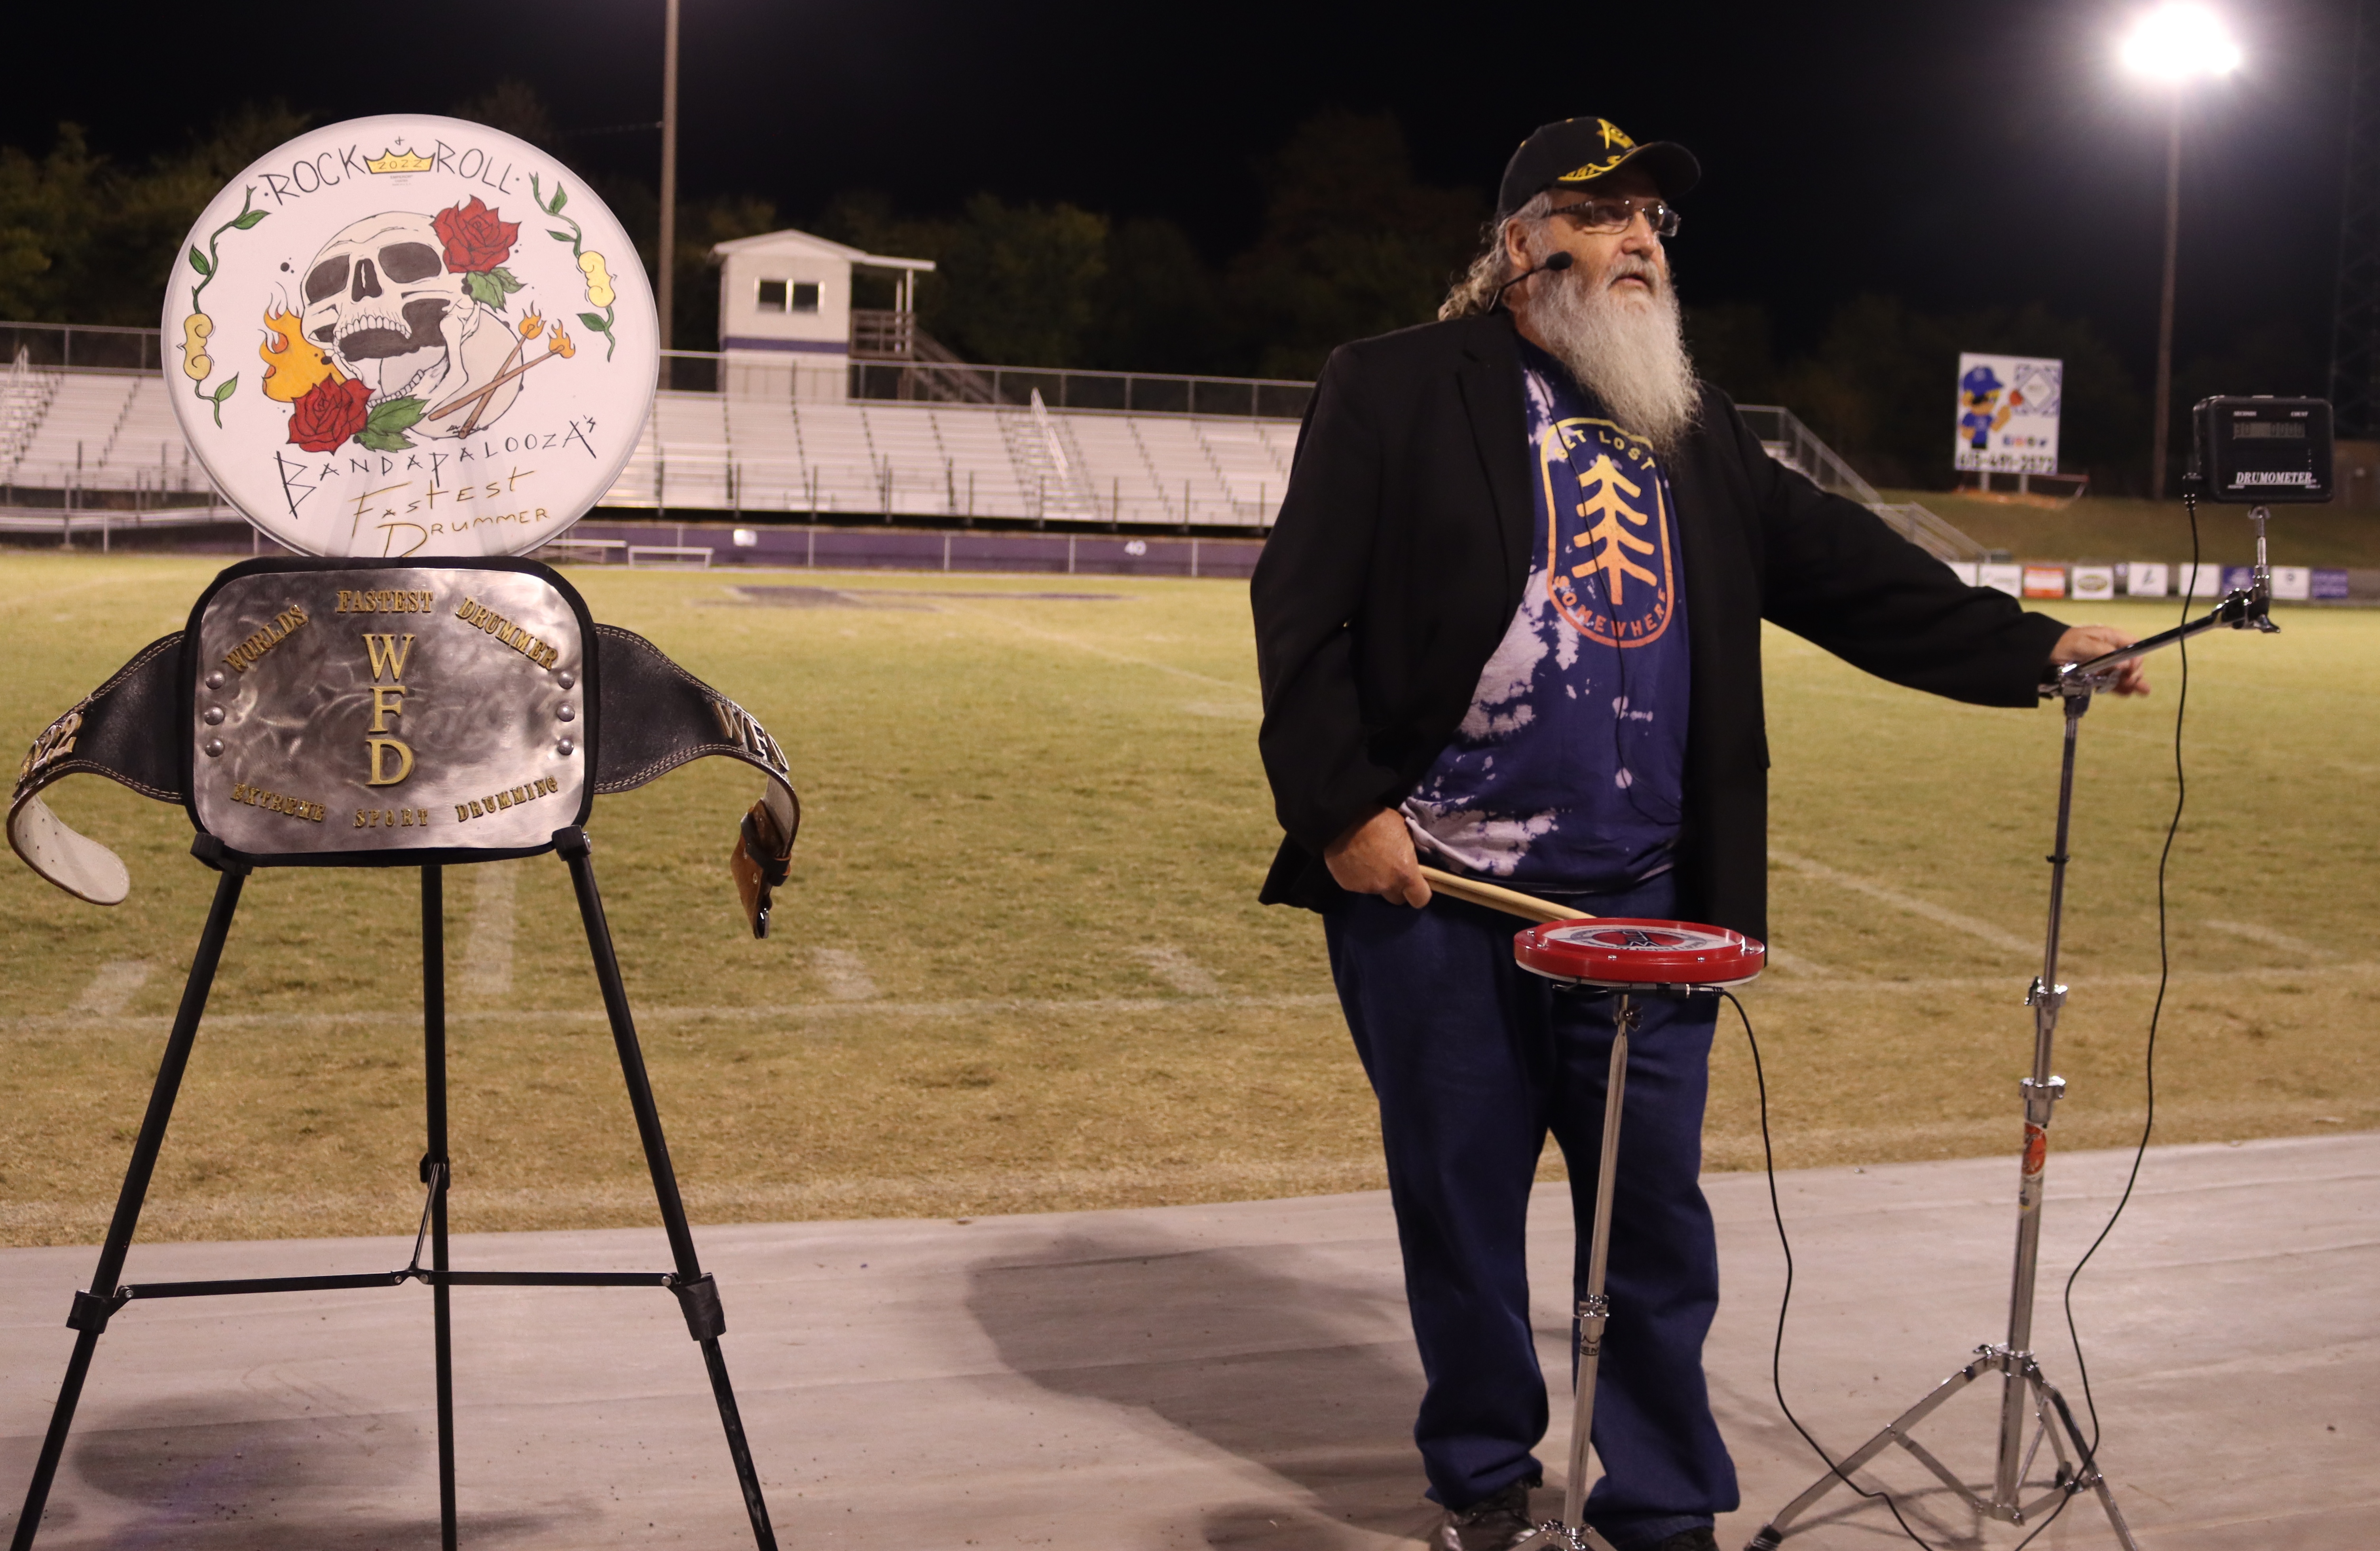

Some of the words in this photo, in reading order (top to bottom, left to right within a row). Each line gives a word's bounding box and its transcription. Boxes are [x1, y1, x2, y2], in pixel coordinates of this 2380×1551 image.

[258, 144, 366, 205] ROCK
[435, 139, 512, 195] ROLL
[377, 159, 422, 170] 2022
[1598, 430, 1656, 470] LOST
[2236, 471, 2313, 484] DRUMOMETER
[223, 604, 309, 673] WORLDS
[335, 590, 434, 613] FASTEST
[455, 596, 560, 671] DRUMMER
[230, 782, 326, 823] EXTREME
[353, 808, 429, 828] SPORT
[456, 775, 559, 822] DRUMMING
